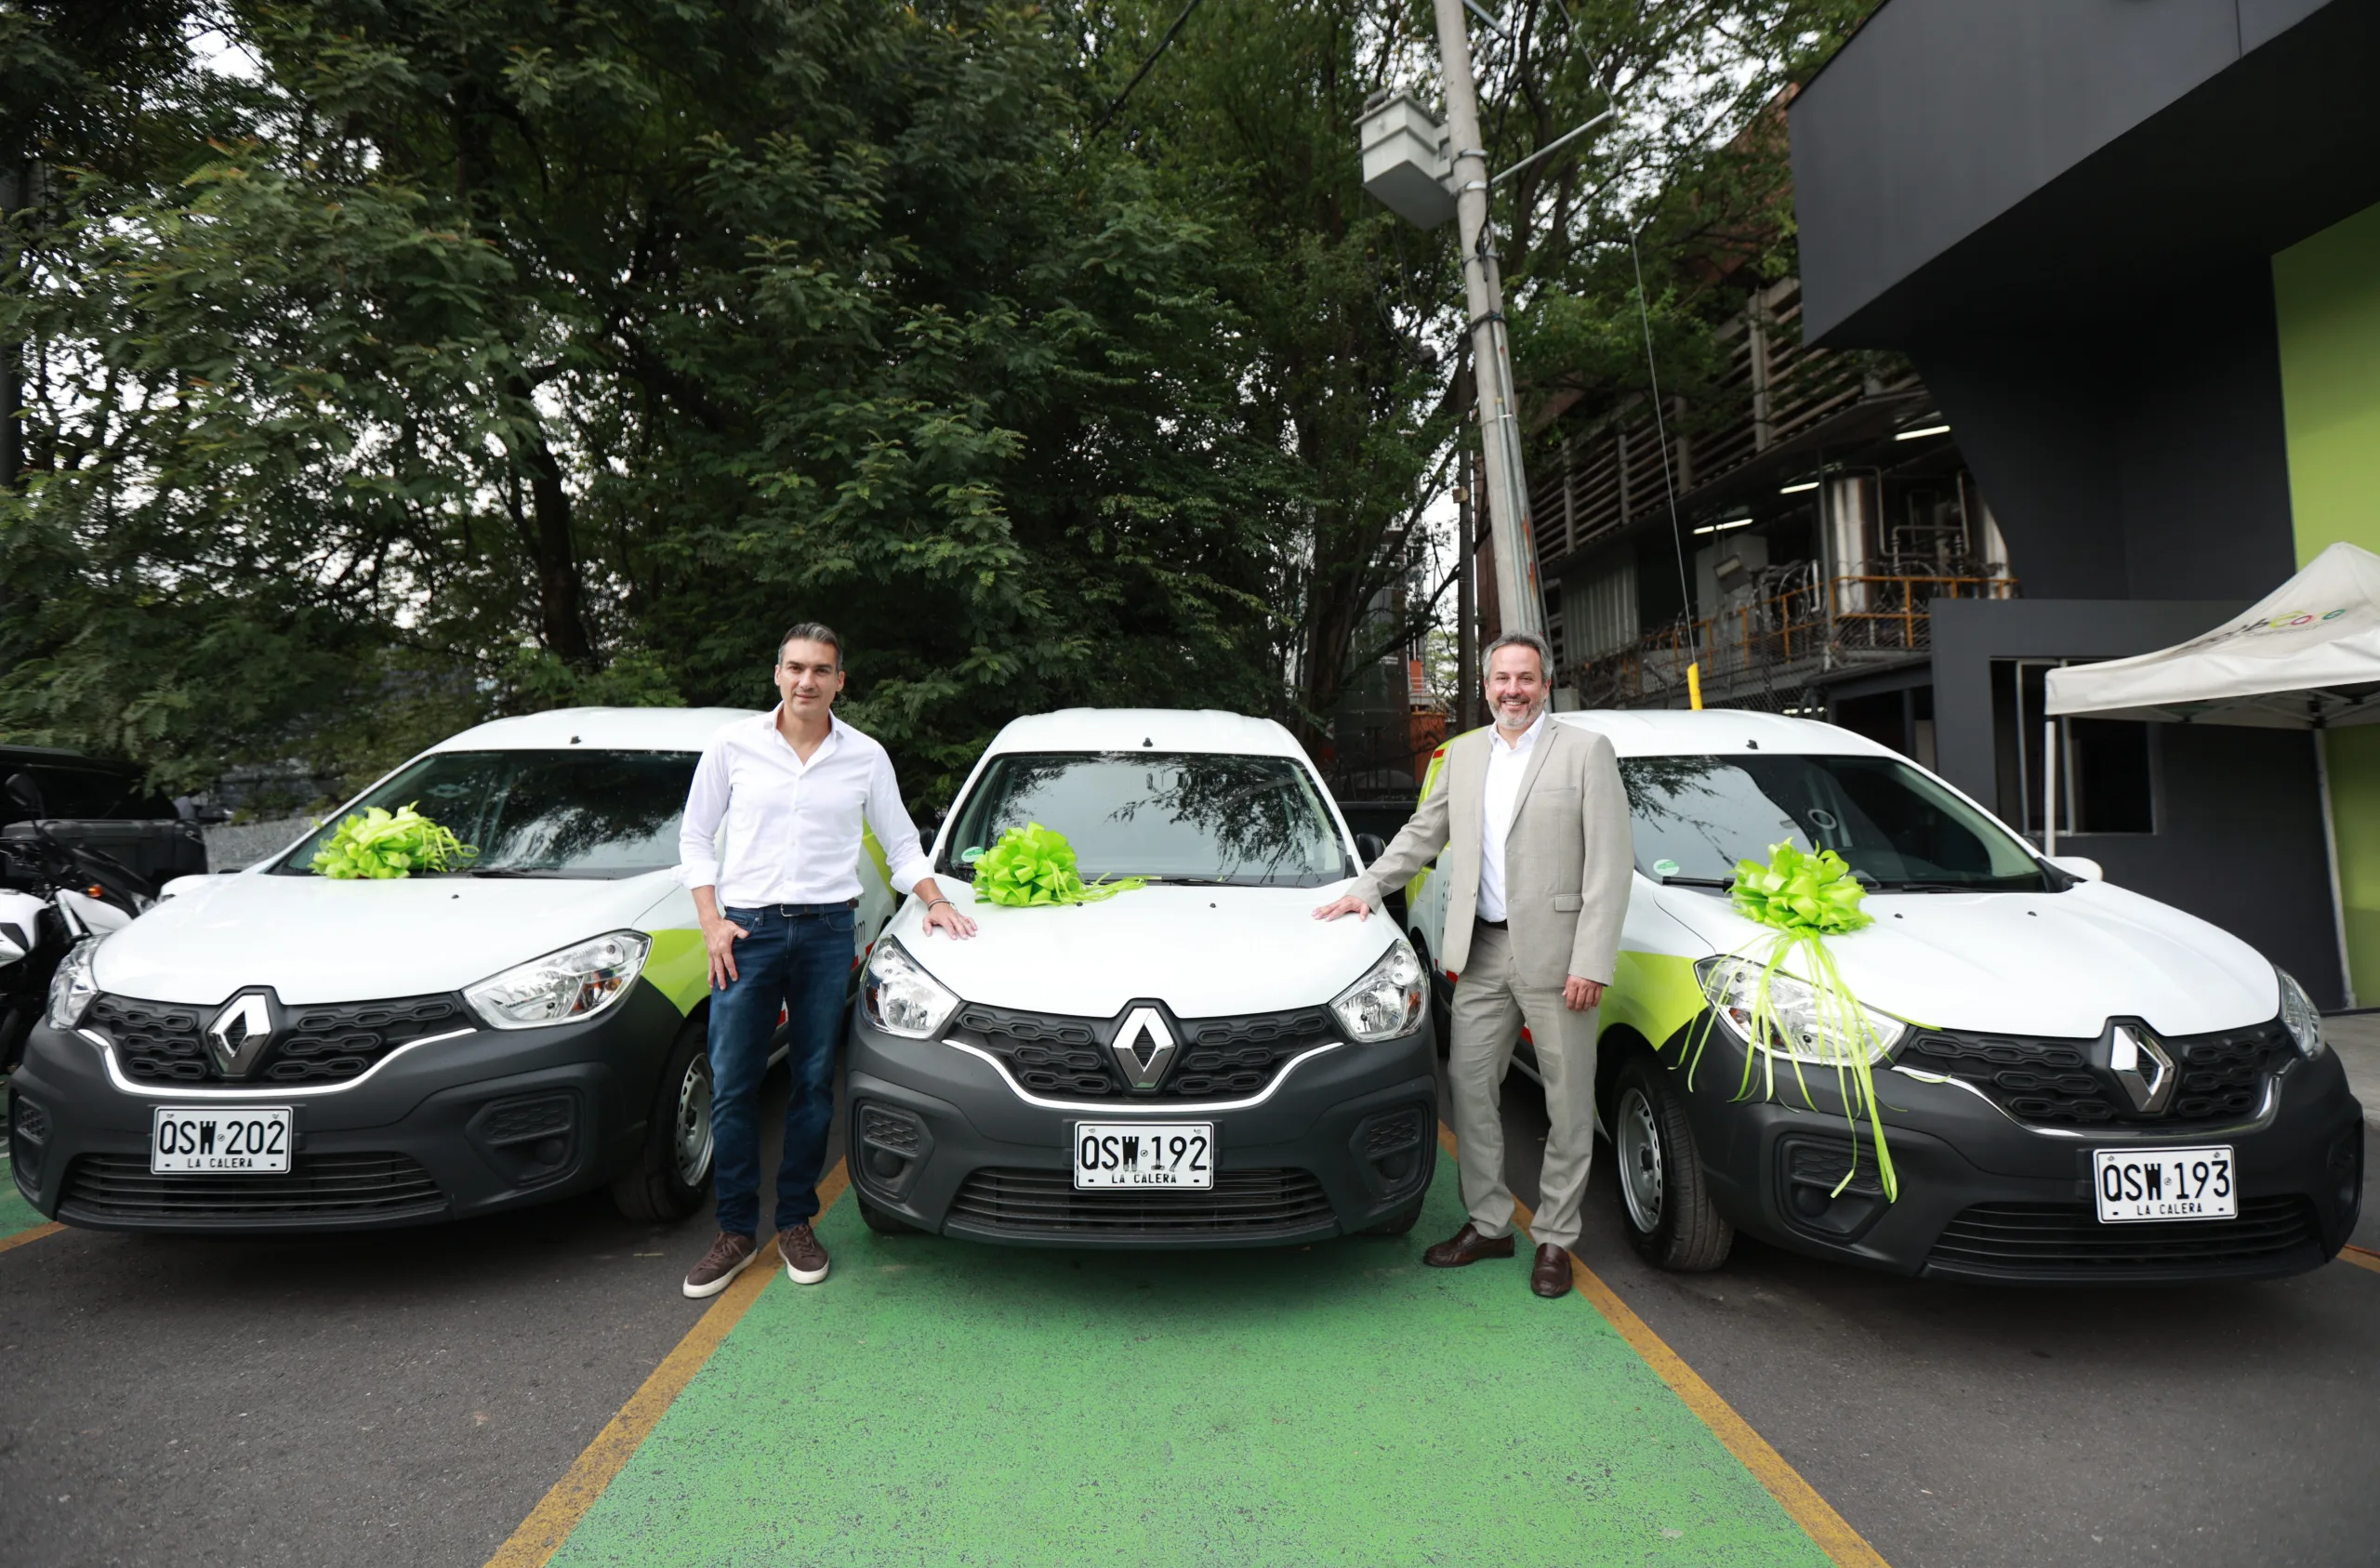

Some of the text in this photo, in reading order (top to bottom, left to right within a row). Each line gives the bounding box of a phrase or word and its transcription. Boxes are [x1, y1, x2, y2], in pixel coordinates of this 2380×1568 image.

[159, 1120, 284, 1154] QSW 202
[188, 1158, 253, 1168] LA CALERA
[1081, 1135, 1208, 1172] QSW 192
[1111, 1174, 1177, 1184] LA CALERA
[2103, 1160, 2230, 1202] QSW 193
[2136, 1203, 2202, 1216] LA CALERA
